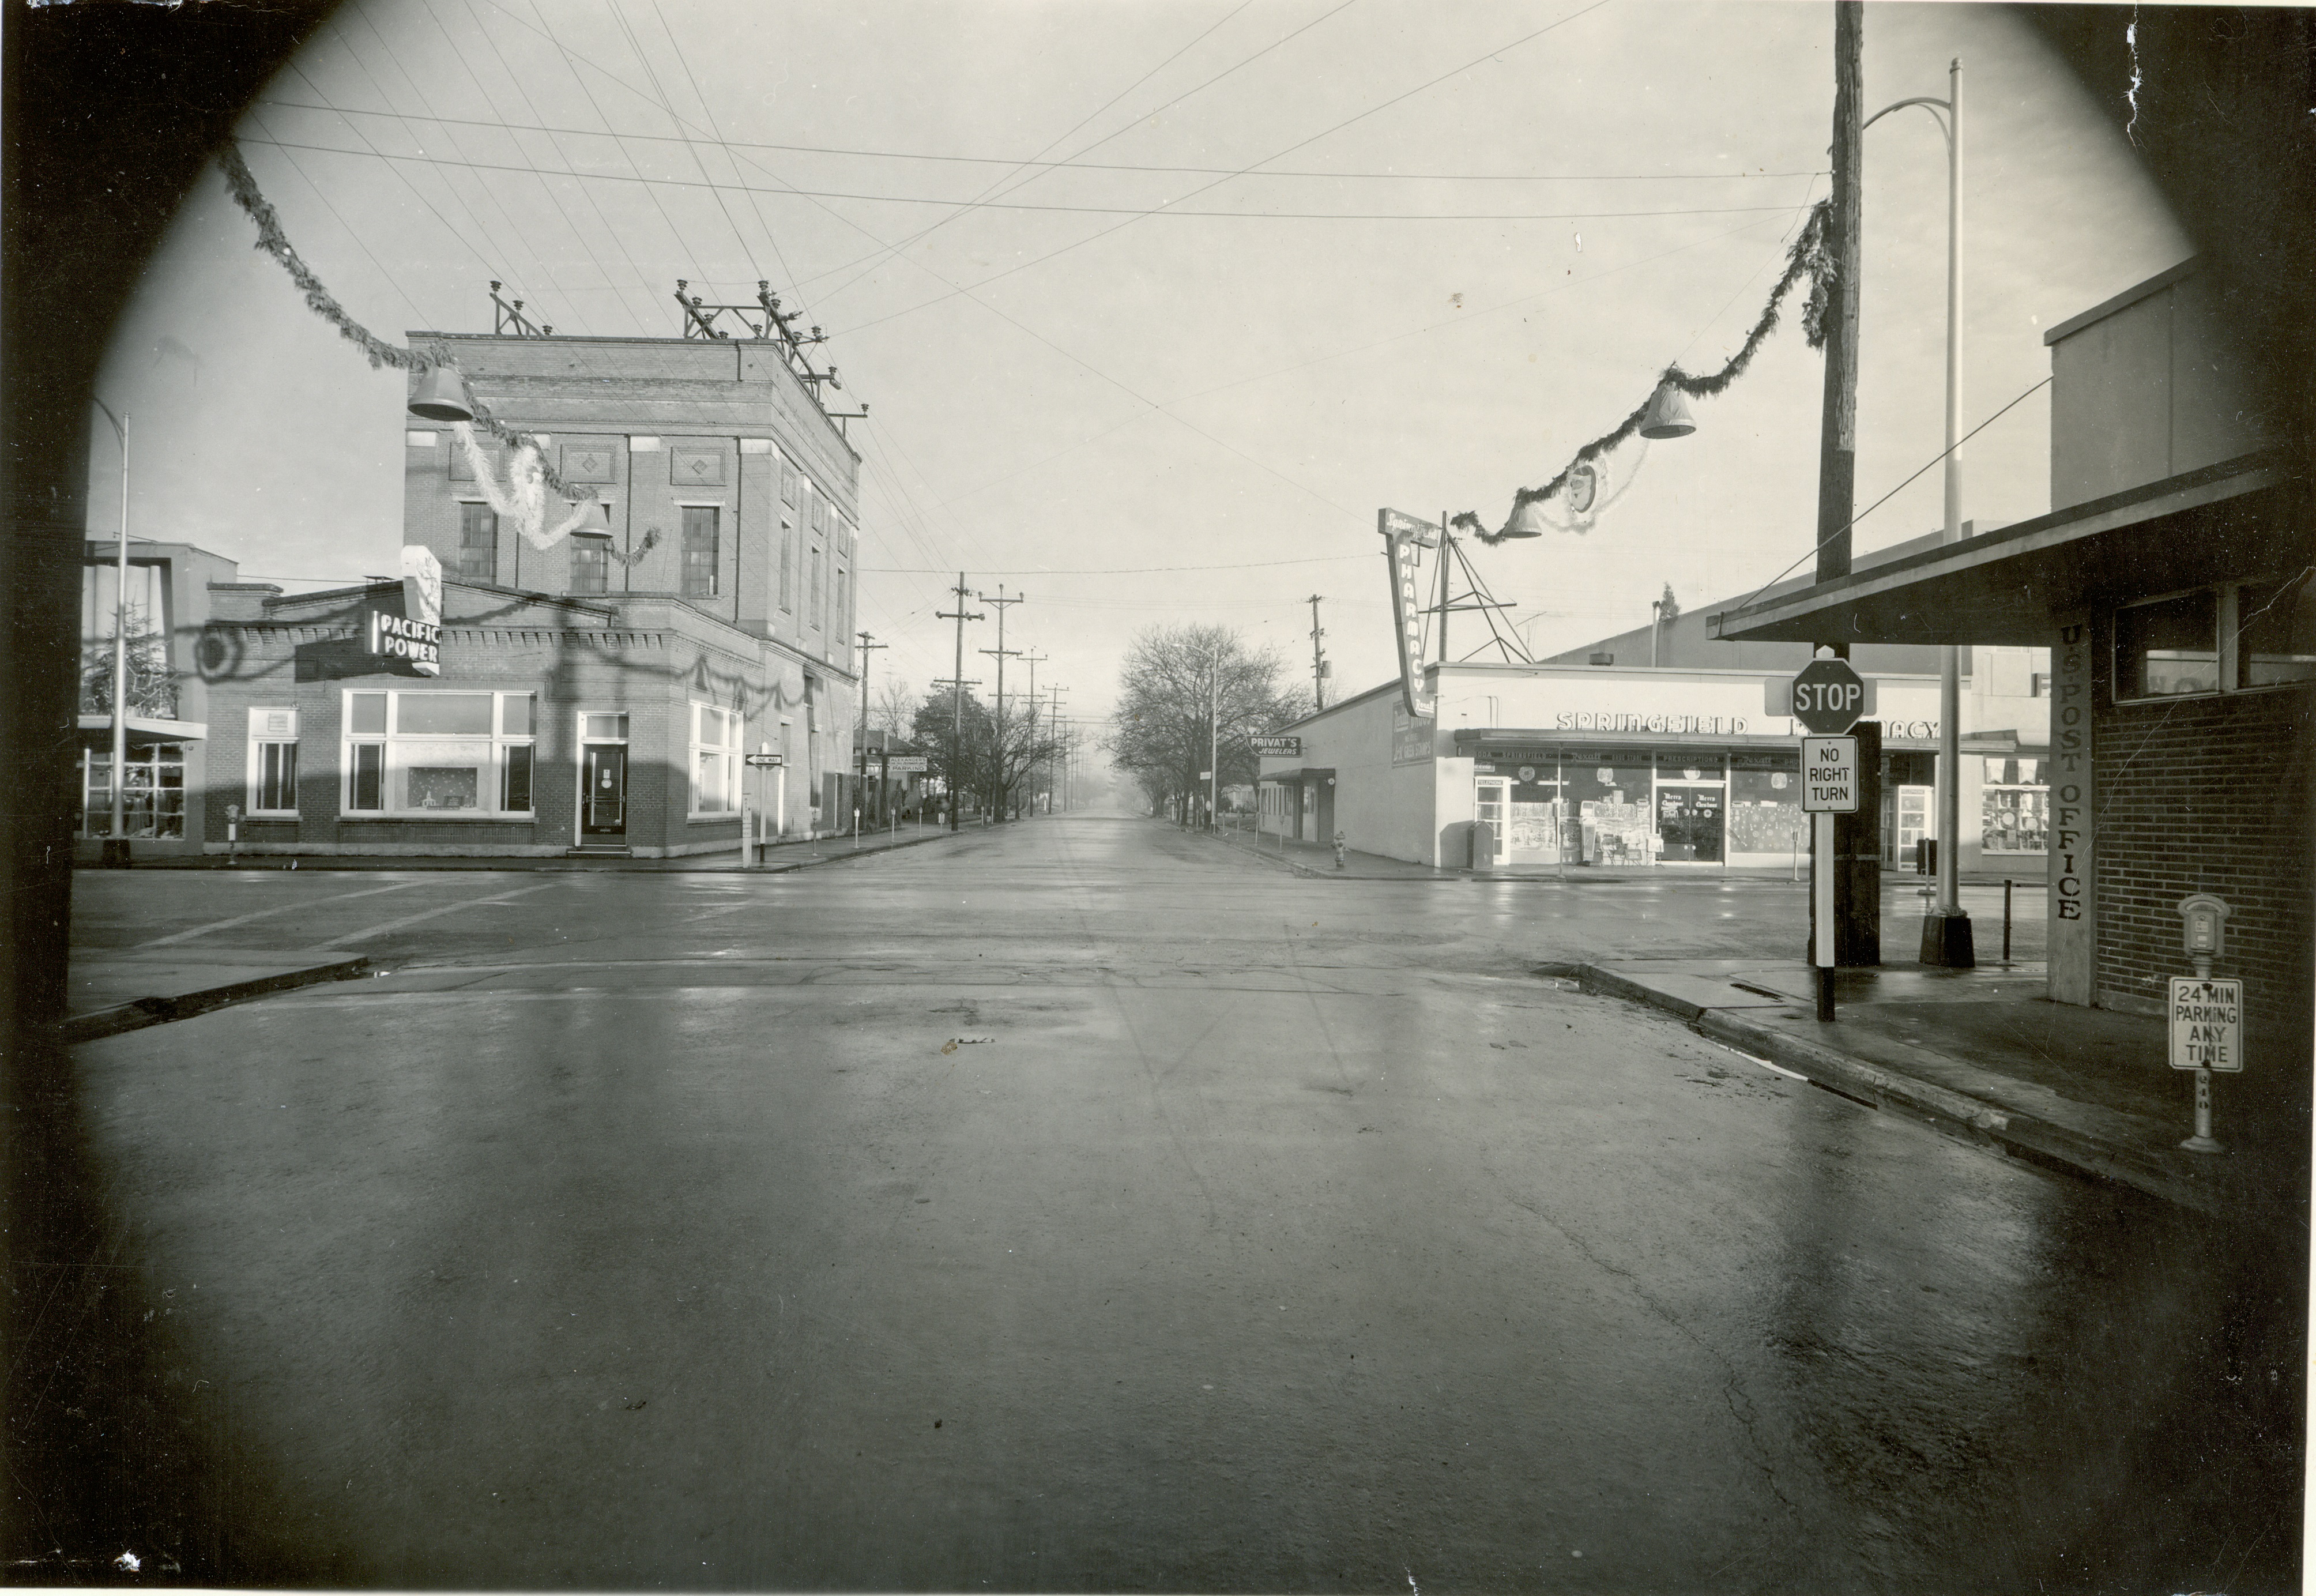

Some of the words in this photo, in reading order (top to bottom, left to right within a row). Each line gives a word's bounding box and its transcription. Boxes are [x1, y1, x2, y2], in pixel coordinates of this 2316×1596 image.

[1399, 544, 1424, 692] PHARMACY
[381, 614, 439, 644] PACIFIC
[385, 636, 438, 663] POWER
[1796, 683, 1861, 711] STOP
[1415, 699, 1434, 713] Rexall
[1557, 712, 1748, 735] SPRINGFIELD
[2060, 684, 2081, 771] POST
[1251, 738, 1297, 747] PRIVAT'S
[1571, 752, 1601, 762] Rexall
[1821, 748, 1839, 762] NO
[1810, 767, 1849, 781] RIGHT
[1812, 787, 1848, 801] TURN
[2058, 785, 2081, 920] OFFICE
[2178, 986, 2201, 1002] 24
[2176, 1006, 2236, 1023] PARKING
[2190, 1026, 2226, 1042] ANY
[2186, 1044, 2228, 1062] TIME
